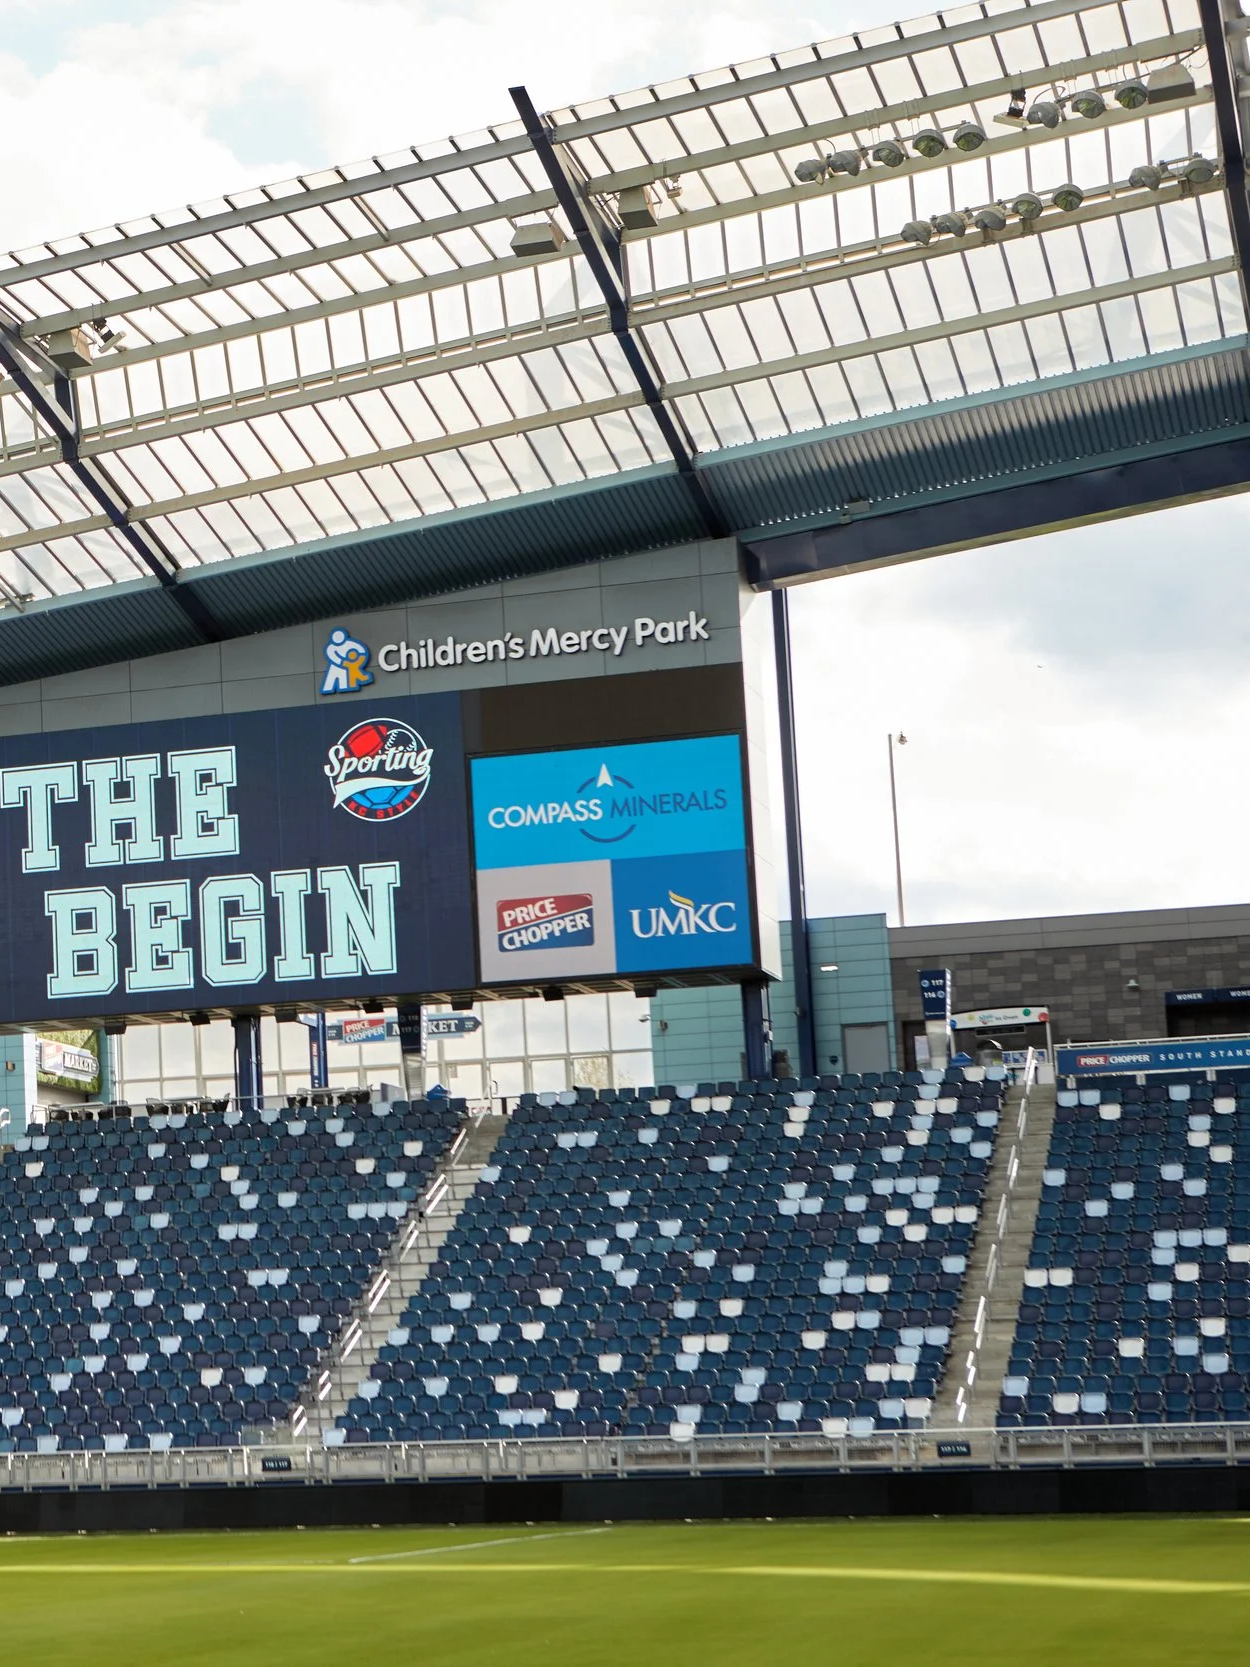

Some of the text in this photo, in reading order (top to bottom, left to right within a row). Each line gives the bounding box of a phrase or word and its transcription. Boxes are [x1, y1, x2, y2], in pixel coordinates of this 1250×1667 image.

[378, 610, 711, 673] Children's Mercy Park
[323, 745, 434, 783] Sporting
[0, 745, 241, 874] THE
[487, 788, 728, 829] COMPASS MINERALS
[45, 861, 401, 1000] BEGIN
[501, 912, 592, 951] CHOPPER
[502, 897, 558, 928] PRICE
[629, 899, 738, 939] UMKC
[345, 1020, 370, 1033] PRICE
[346, 1026, 384, 1043] CHOPPER
[1080, 1056, 1106, 1066] PRICE
[1109, 1054, 1150, 1064] CHOPPER
[1159, 1051, 1202, 1061] SOUTH
